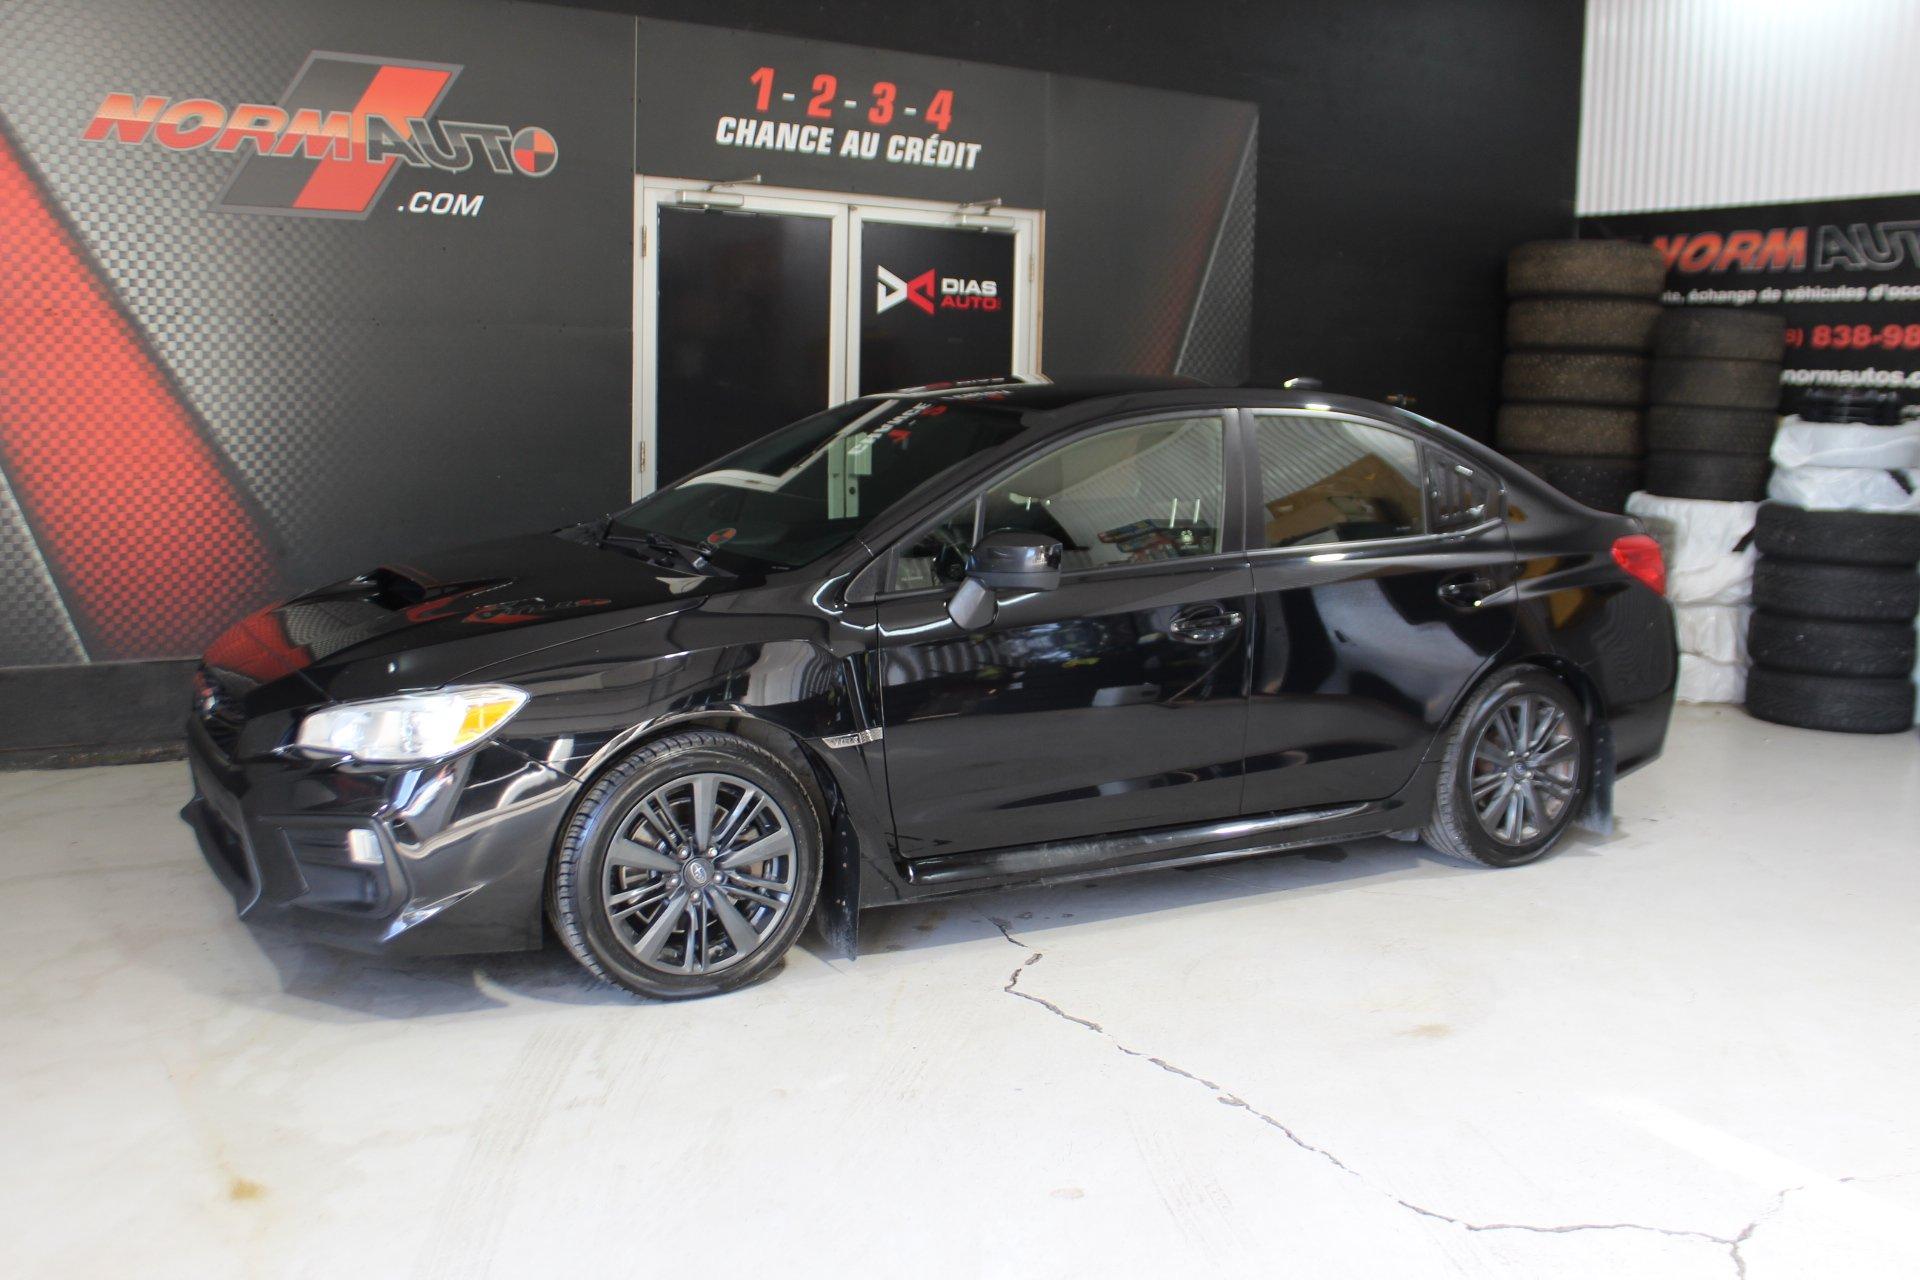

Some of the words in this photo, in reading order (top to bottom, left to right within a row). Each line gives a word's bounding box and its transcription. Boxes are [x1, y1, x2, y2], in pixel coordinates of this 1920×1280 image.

[715, 115, 835, 156] CHANCE
[838, 129, 881, 160] AU
[885, 133, 982, 171] CRÉDIT
[397, 190, 484, 218] .COM
[940, 277, 998, 297] DIAS
[1687, 288, 1757, 307] échange
[1758, 286, 1782, 304] de
[1783, 284, 1867, 303] véhicules
[940, 295, 1001, 312] AUTO
